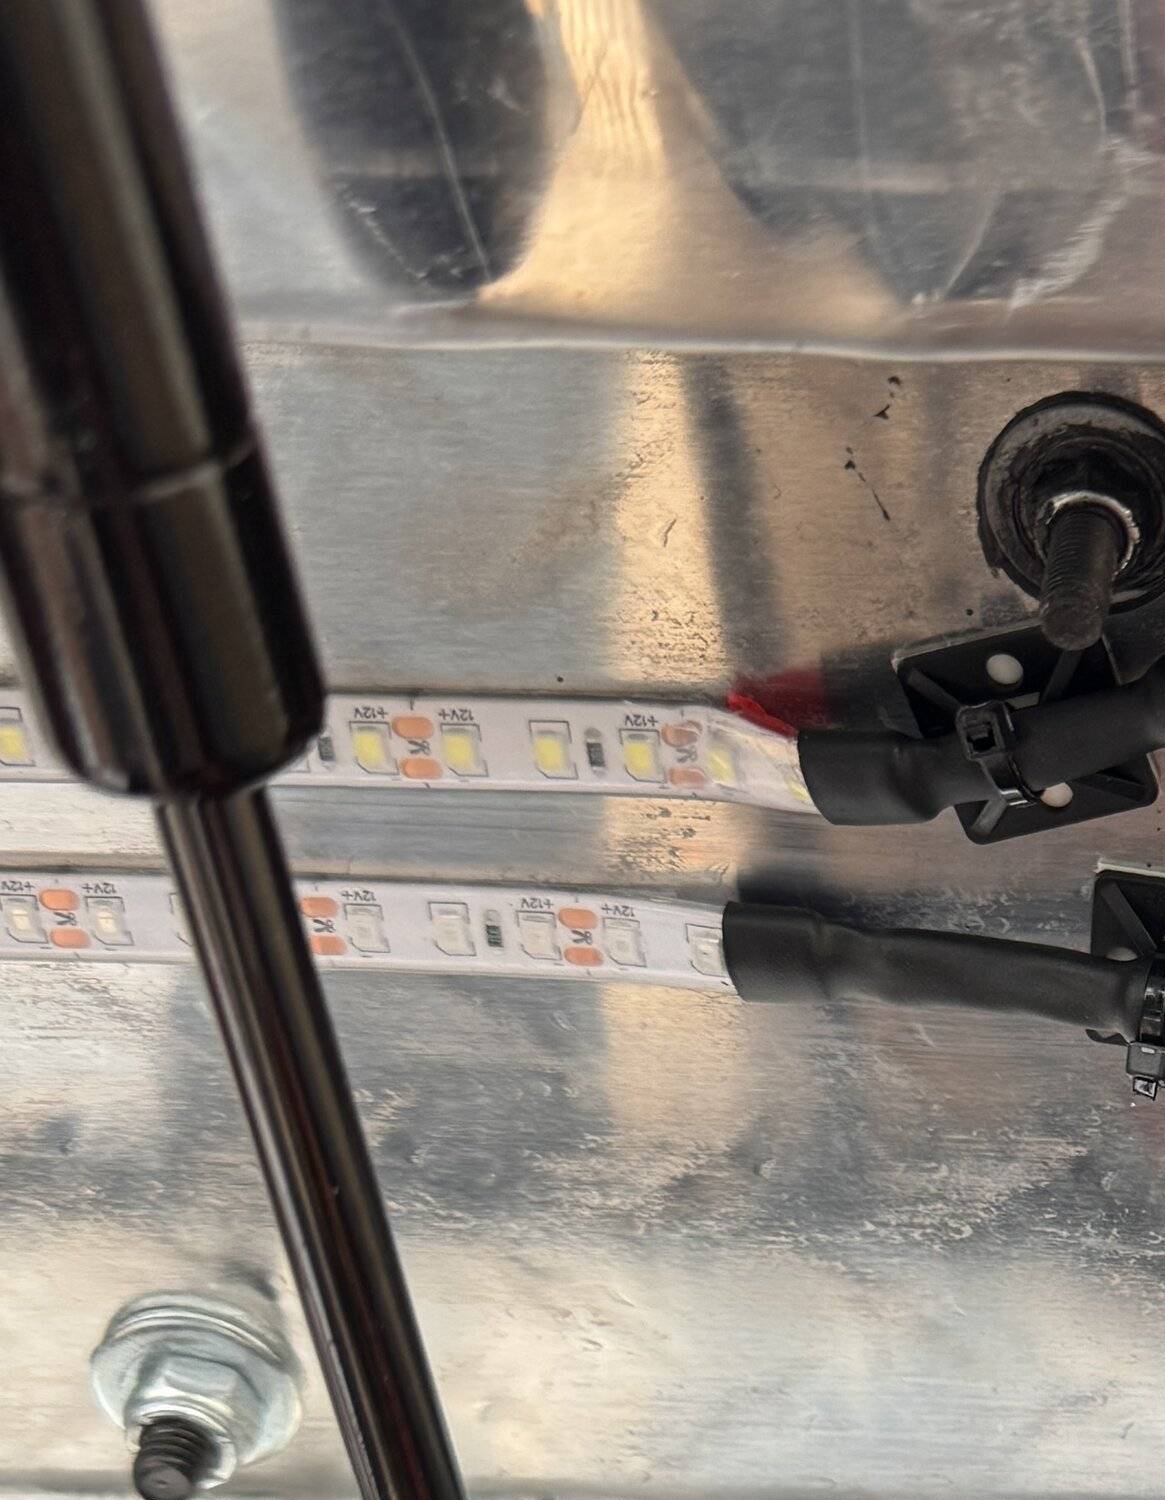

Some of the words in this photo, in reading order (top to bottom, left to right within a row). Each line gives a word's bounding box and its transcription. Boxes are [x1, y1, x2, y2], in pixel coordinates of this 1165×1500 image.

[354, 707, 388, 720] +12V
[438, 708, 474, 721] 12V+
[624, 714, 659, 728] +12V
[81, 882, 117, 894] 12V+
[341, 889, 377, 902] 12V+
[520, 897, 554, 909] +12V
[601, 903, 636, 917] 12V+
